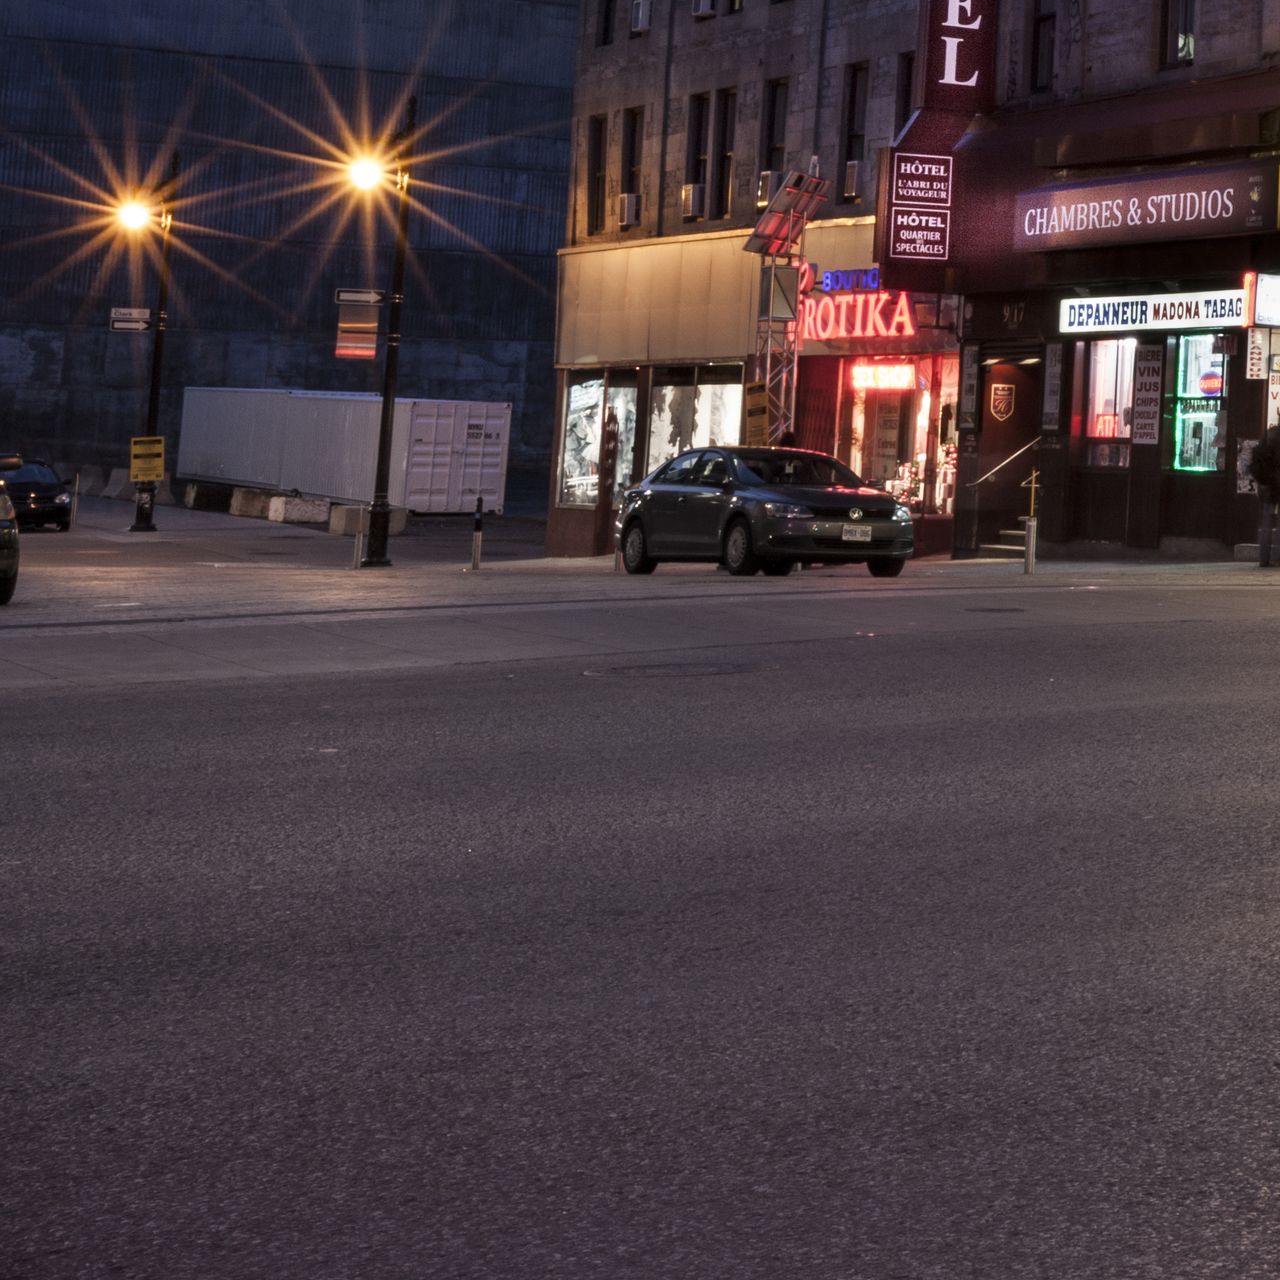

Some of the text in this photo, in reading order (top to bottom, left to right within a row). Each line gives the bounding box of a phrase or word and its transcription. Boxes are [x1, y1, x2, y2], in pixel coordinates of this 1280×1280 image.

[900, 160, 948, 177] HÔTEL
[898, 179, 948, 191] L'ABRI DU
[898, 188, 948, 199] VOYAGEUR
[1024, 187, 1235, 236] CHAMBRES & STUDIOS
[896, 212, 945, 228] HÔTEL
[900, 230, 941, 241] QUARTIER
[896, 243, 944, 254] SPECTACLES
[823, 268, 880, 291] BOUTIQ
[1152, 300, 1201, 321] MADONA
[1204, 296, 1243, 319] TABAG
[1138, 366, 1160, 377] VIN
[1136, 382, 1160, 393] JUS
[1136, 397, 1159, 408] CHIPS
